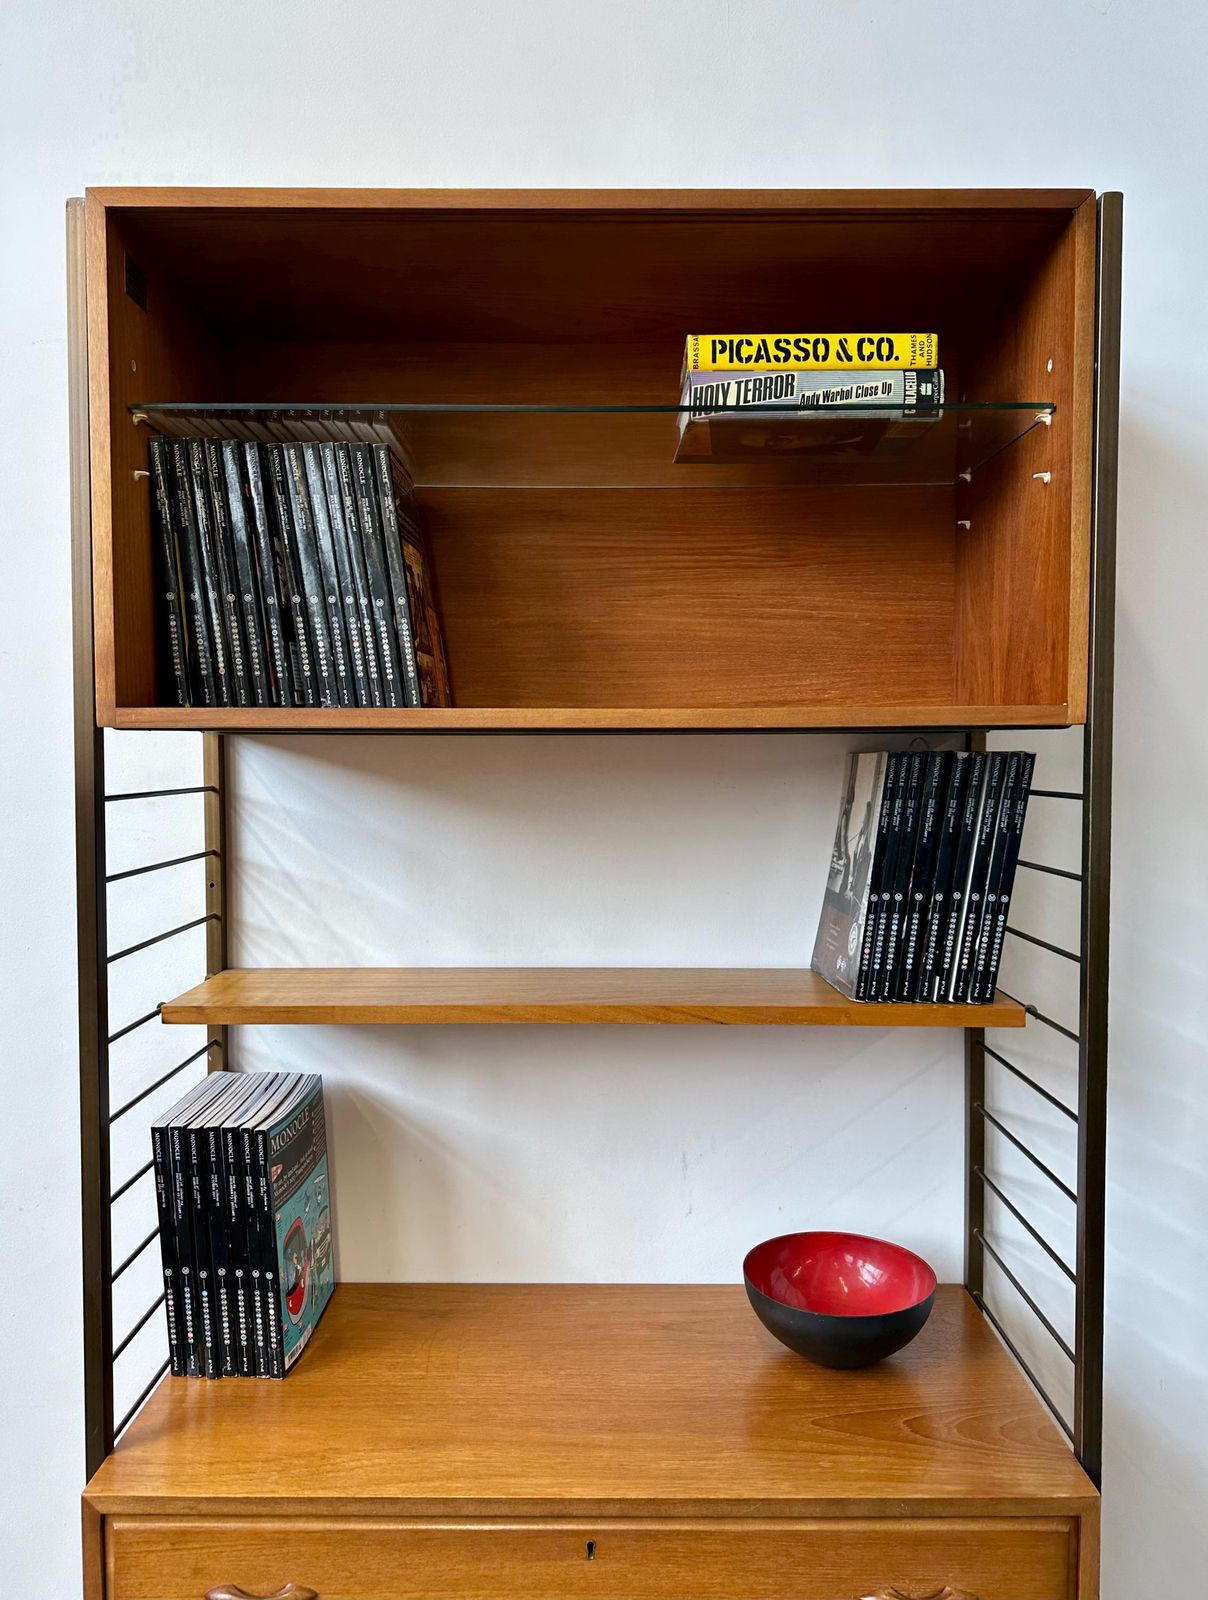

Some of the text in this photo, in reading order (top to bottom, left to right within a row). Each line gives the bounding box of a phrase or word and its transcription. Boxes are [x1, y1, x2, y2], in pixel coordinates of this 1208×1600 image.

[711, 337, 900, 364] PICASSO & CO.
[692, 373, 796, 417] HOLY TERROR
[800, 381, 893, 405] Andy Warhol Close Up
[174, 444, 182, 476] MONOCLE
[192, 442, 201, 475] MONOCLE
[210, 445, 218, 477] MONOCLE
[273, 449, 282, 481] MONOCLE
[290, 449, 298, 481] MONOCLE
[325, 448, 334, 480] MONOCLE
[339, 450, 348, 483] MONOCLE
[356, 452, 365, 484] MONOCLE
[380, 450, 388, 483] MONOCLE
[887, 758, 896, 788] MONOCLE
[899, 757, 907, 786] MONOCLE
[912, 757, 920, 786] MONOCLE
[933, 756, 941, 786] MONOCLE
[972, 756, 982, 785] MONOCLE
[992, 756, 1000, 786] MONOCLE
[1009, 756, 1017, 786] MONOCLE
[1022, 759, 1031, 788] MONOCLE
[270, 1106, 310, 1155] MONOCLE
